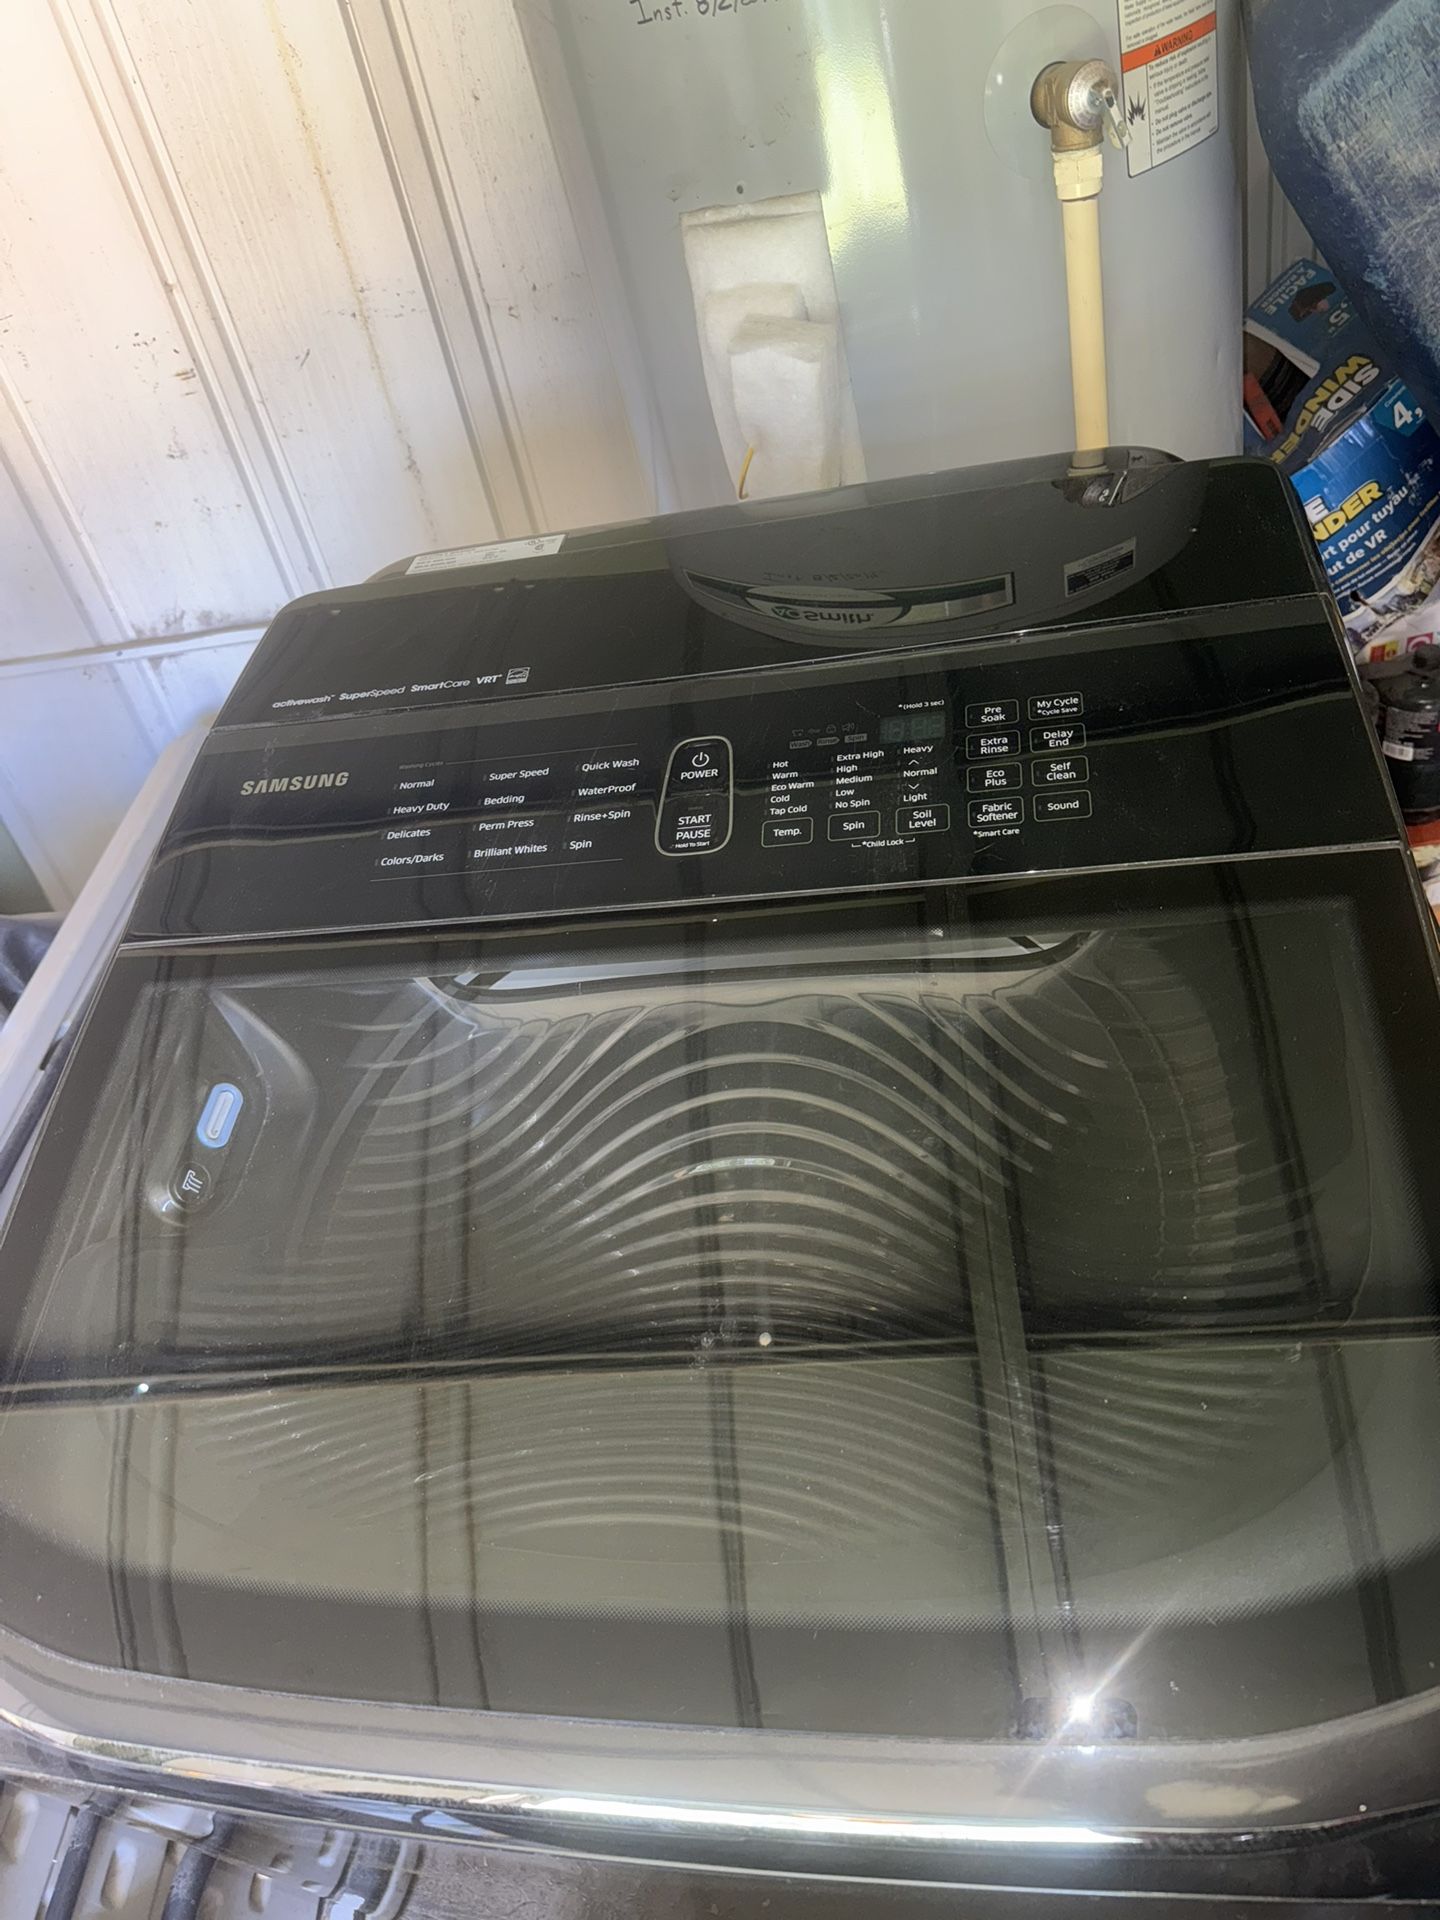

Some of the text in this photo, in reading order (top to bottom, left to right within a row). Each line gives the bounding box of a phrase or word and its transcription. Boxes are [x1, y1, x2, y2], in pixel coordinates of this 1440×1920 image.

[629, 0, 688, 25] Inst.
[1311, 362, 1380, 432] SIDE
[1313, 482, 1383, 541] NDER
[1338, 520, 1372, 552] pour
[1371, 486, 1409, 523] tuyau
[1345, 548, 1365, 565] de
[1364, 528, 1388, 550] VR
[338, 686, 406, 701] SuperSpeed
[410, 677, 471, 693] SmartCare
[930, 699, 945, 708] sec)
[1036, 696, 1079, 709] My Cycle
[984, 706, 1001, 715] Pre
[1060, 706, 1078, 714] Save
[980, 713, 1006, 723] Soak
[1043, 729, 1074, 740] Delay
[980, 737, 1008, 747] Extra
[1049, 738, 1069, 748] End
[903, 744, 934, 755] Heavy
[980, 745, 1009, 755] Rinse
[836, 749, 885, 762] Extra High
[581, 758, 640, 773] Quick Wash
[773, 760, 789, 769] Hot
[836, 764, 858, 775] High
[1050, 761, 1072, 772] Self
[489, 767, 550, 782] Super Speed
[680, 768, 719, 780] POWER
[772, 771, 799, 780] Warm
[903, 767, 938, 778] Normal
[986, 770, 1005, 778] Eco
[1046, 770, 1077, 781] Clean
[240, 771, 350, 796] SAMSUNG
[399, 779, 435, 790] Normal
[836, 775, 873, 785] Medium
[984, 778, 1007, 787] Plus
[578, 783, 637, 797] WaterProof
[771, 780, 815, 792] Eco Warm
[835, 788, 855, 797] Low
[903, 793, 928, 803] Light
[484, 795, 525, 806] Bedding
[770, 794, 790, 804] Cold
[835, 798, 871, 809] No Spin
[393, 801, 451, 814] Heavy Duty
[770, 805, 808, 816] Tap Cold
[982, 802, 1013, 813] Fabric
[1047, 800, 1080, 811] Sound
[573, 809, 631, 823] Rinse+Spin
[912, 809, 932, 819] Soil
[977, 811, 1019, 823] Softener
[478, 819, 535, 832] Perm Press
[678, 814, 712, 826] START
[909, 818, 937, 829] Level
[842, 820, 865, 832] Spin
[387, 829, 432, 840] Delicates
[676, 829, 711, 840] PAUSE
[773, 828, 802, 838] Temp.
[1002, 828, 1020, 836] Care
[569, 839, 593, 851] Spin
[887, 838, 904, 847] Lock
[474, 844, 548, 858] Brilliant Whites
[380, 853, 445, 867] Colors/Darks
